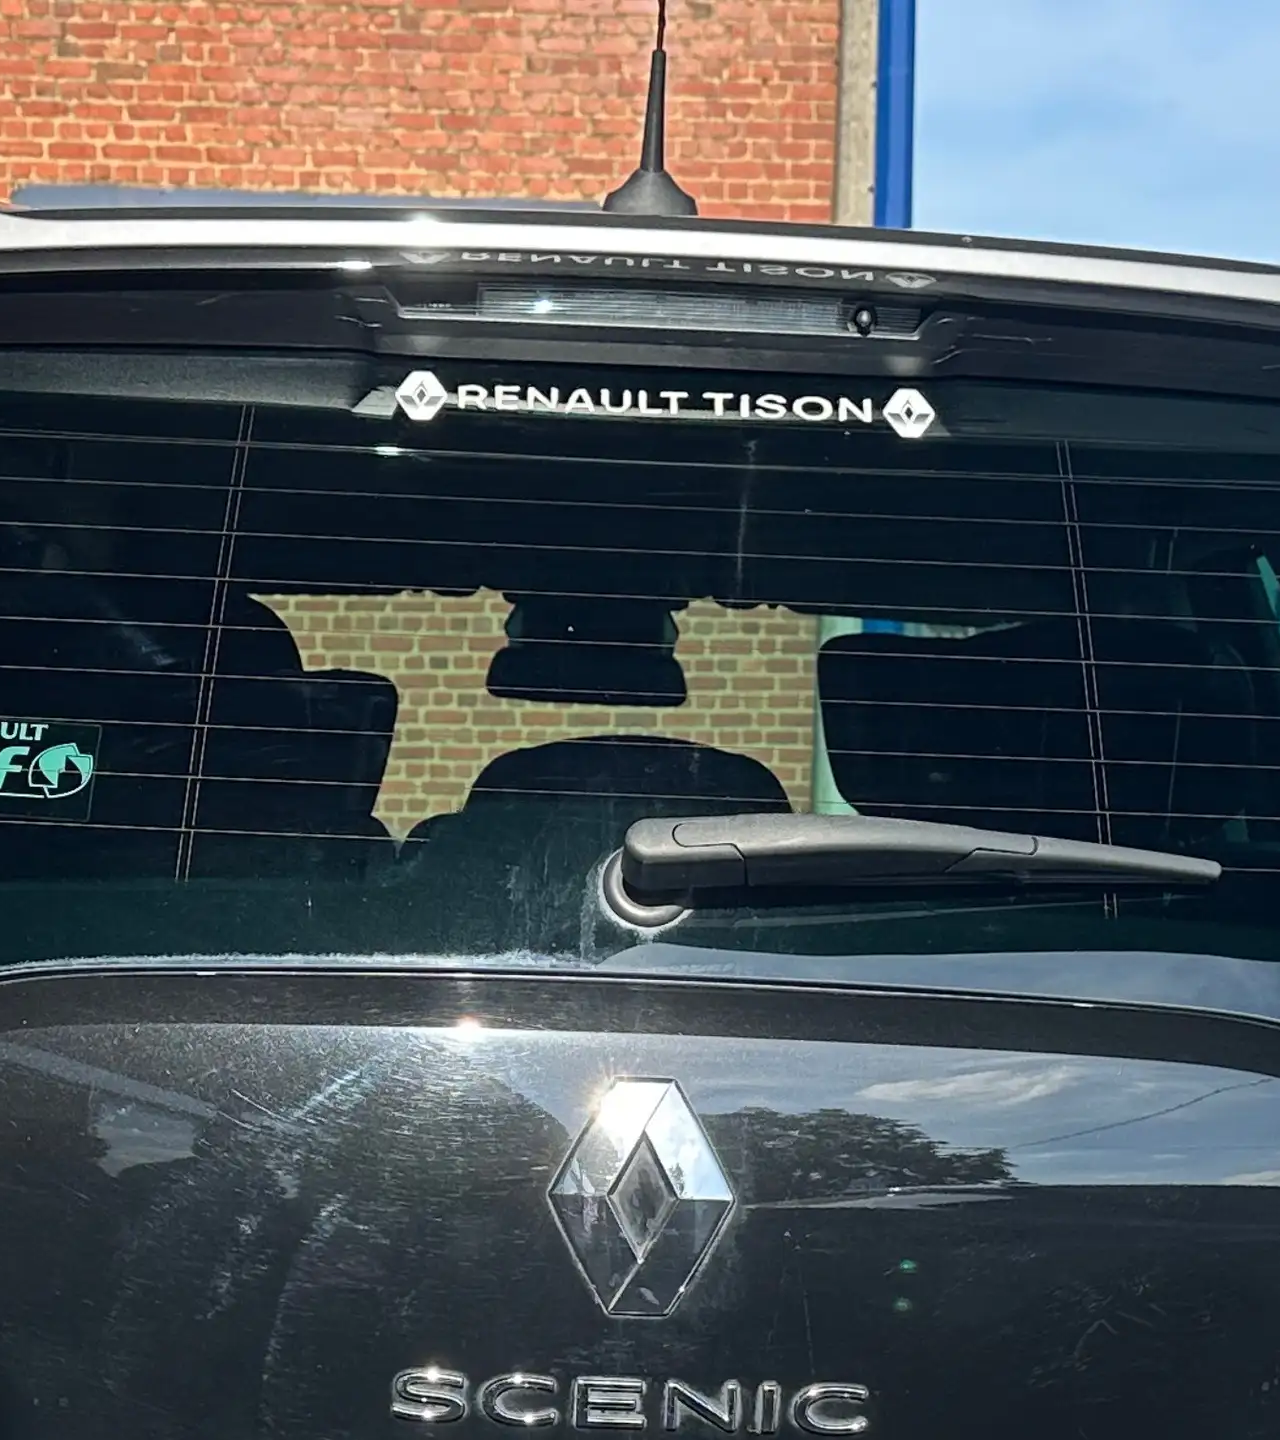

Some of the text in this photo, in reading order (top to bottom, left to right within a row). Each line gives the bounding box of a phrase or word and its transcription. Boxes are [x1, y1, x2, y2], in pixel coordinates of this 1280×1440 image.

[456, 383, 873, 424] RENAULT TISON
[390, 1365, 870, 1437] SCENIC
